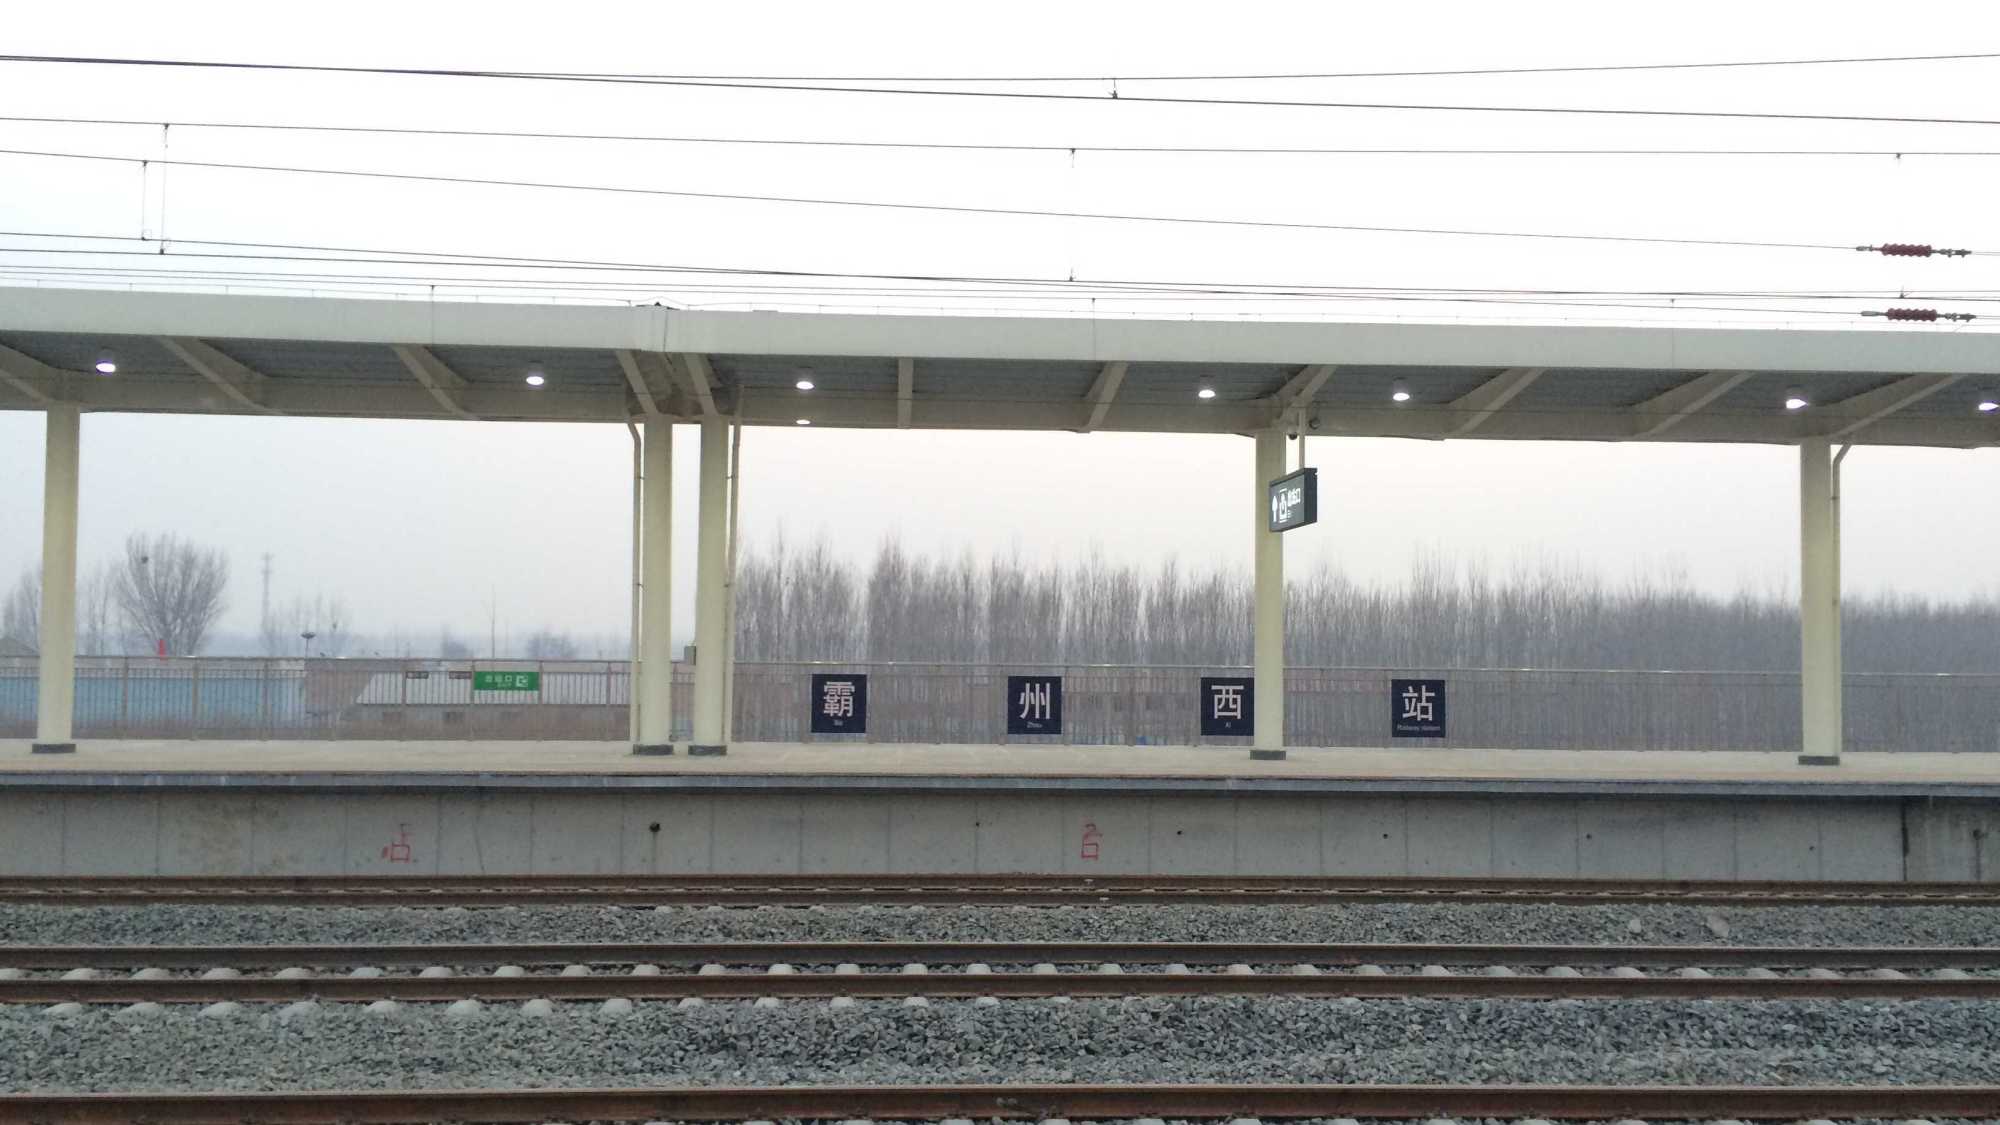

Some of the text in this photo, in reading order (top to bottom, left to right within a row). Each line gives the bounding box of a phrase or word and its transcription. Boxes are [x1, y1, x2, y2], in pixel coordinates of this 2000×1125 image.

[823, 681, 855, 717] 霸
[1019, 682, 1051, 719] 州
[1211, 685, 1244, 719] 西
[1402, 685, 1435, 721] 站
